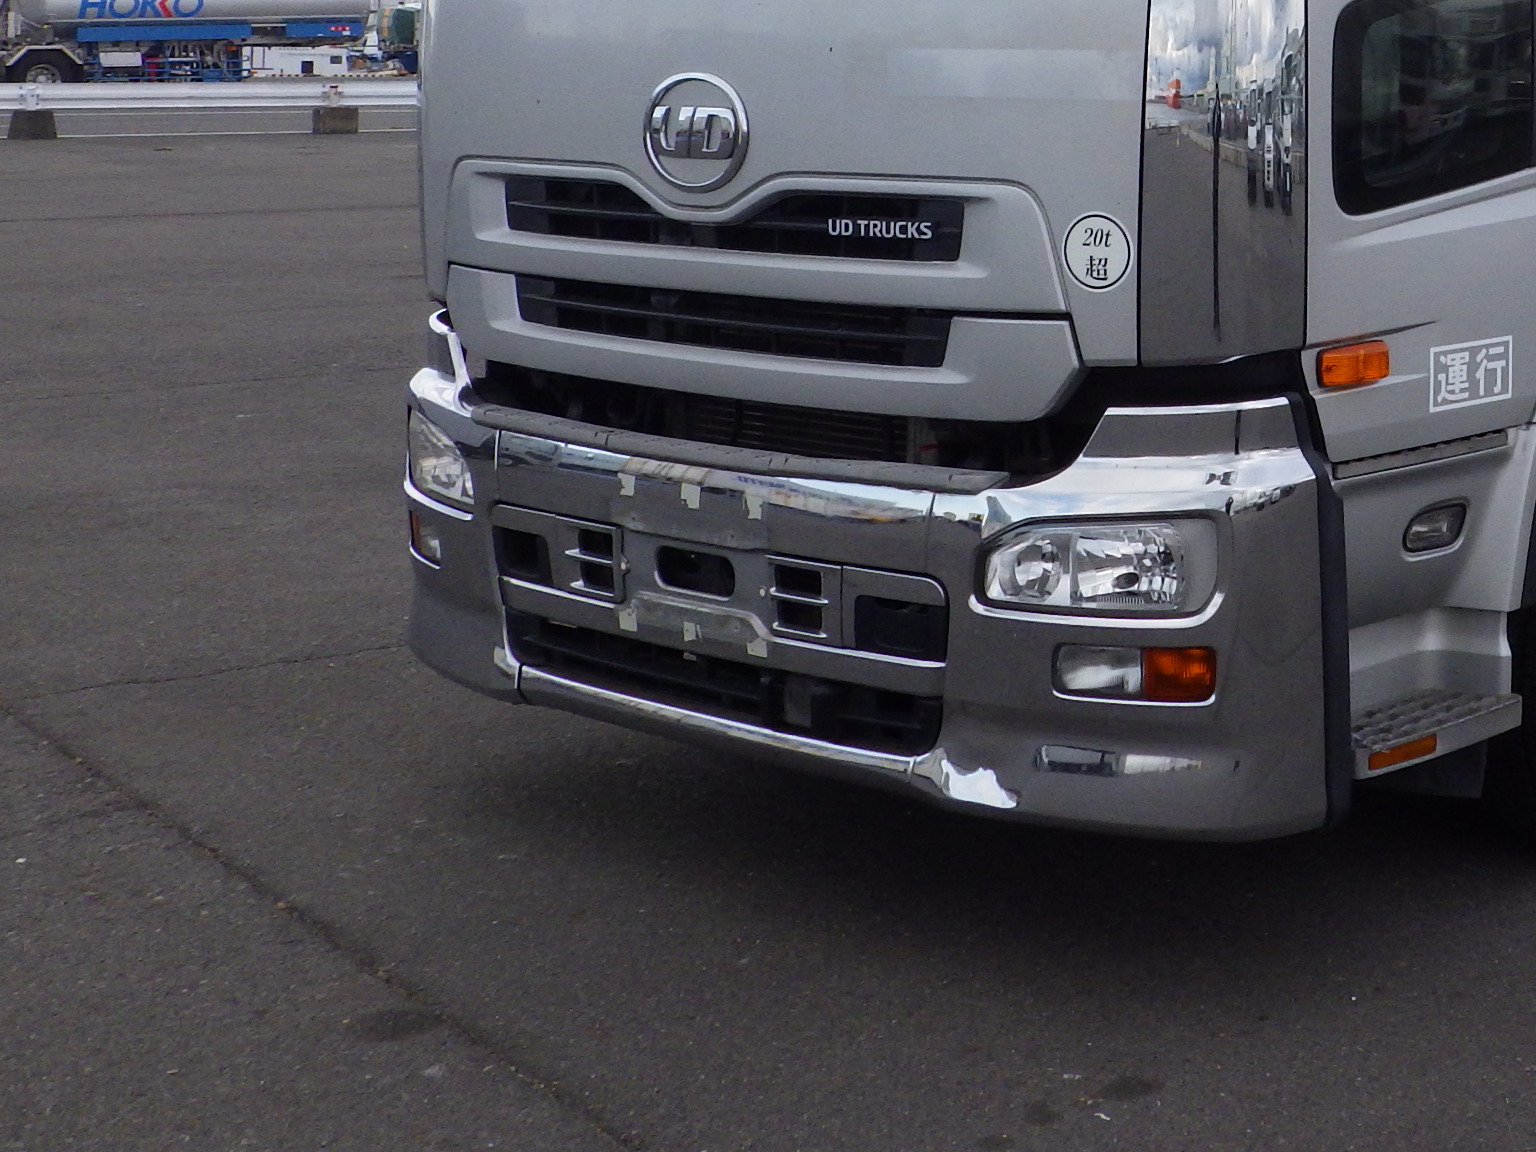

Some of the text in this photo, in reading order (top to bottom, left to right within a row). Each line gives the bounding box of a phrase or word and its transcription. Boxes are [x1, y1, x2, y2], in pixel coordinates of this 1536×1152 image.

[650, 105, 735, 160] UD
[828, 218, 933, 239] UD TRUCKS
[1082, 227, 1112, 248] 20t
[1084, 255, 1108, 281] 超
[1437, 345, 1507, 403] 運行
